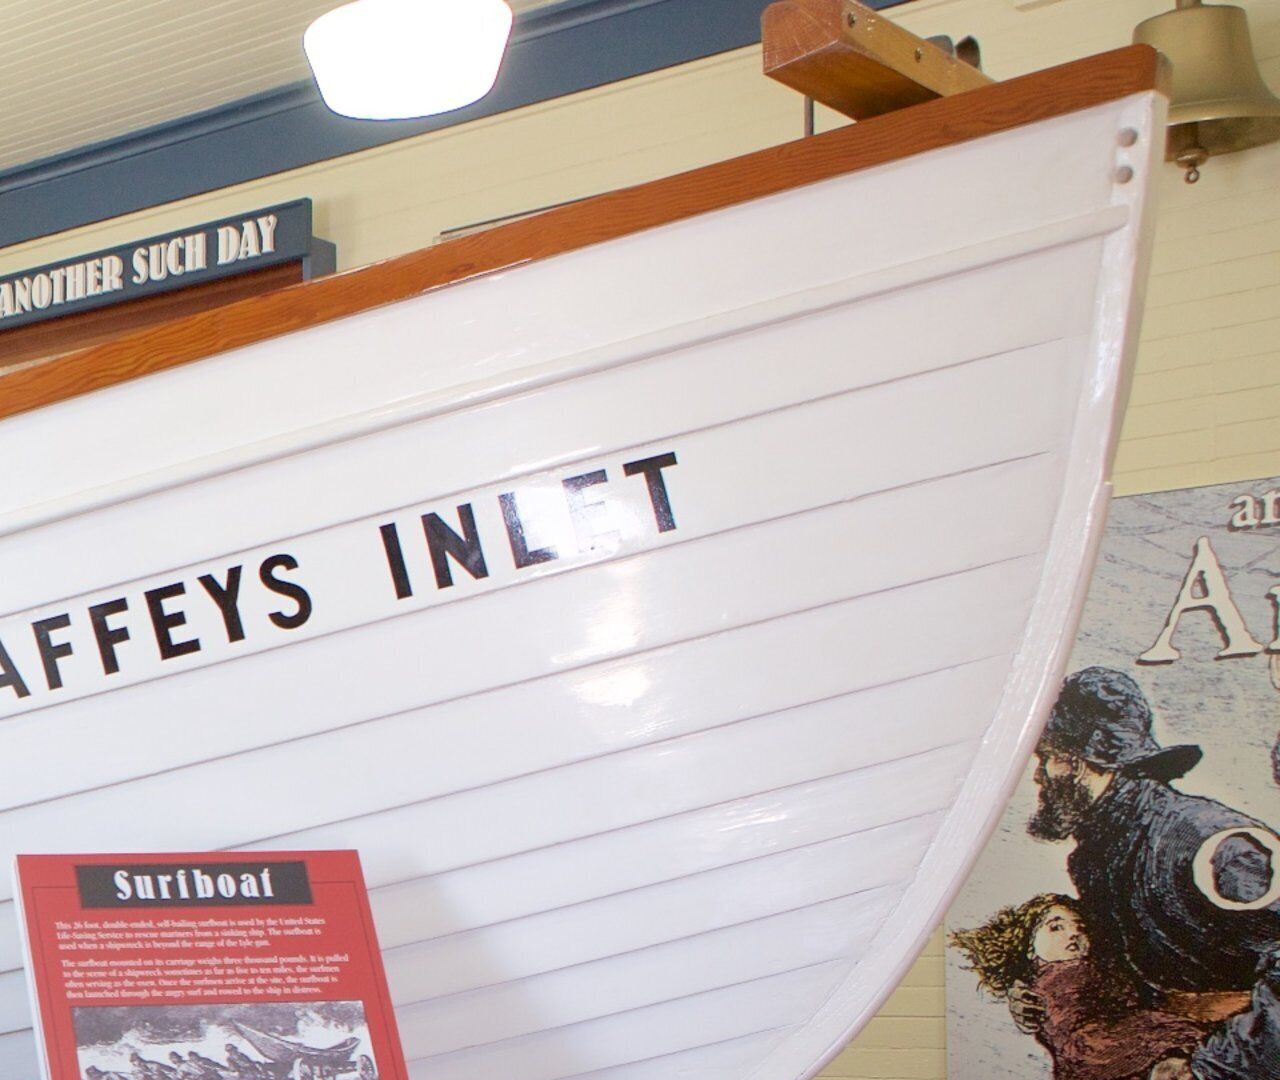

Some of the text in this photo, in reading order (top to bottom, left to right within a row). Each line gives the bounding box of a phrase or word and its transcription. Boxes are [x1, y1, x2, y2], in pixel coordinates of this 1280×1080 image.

[132, 231, 207, 285] SUCH
[217, 213, 278, 265] DAY
[378, 451, 679, 600] INLET
[113, 867, 275, 900] Surfboat
